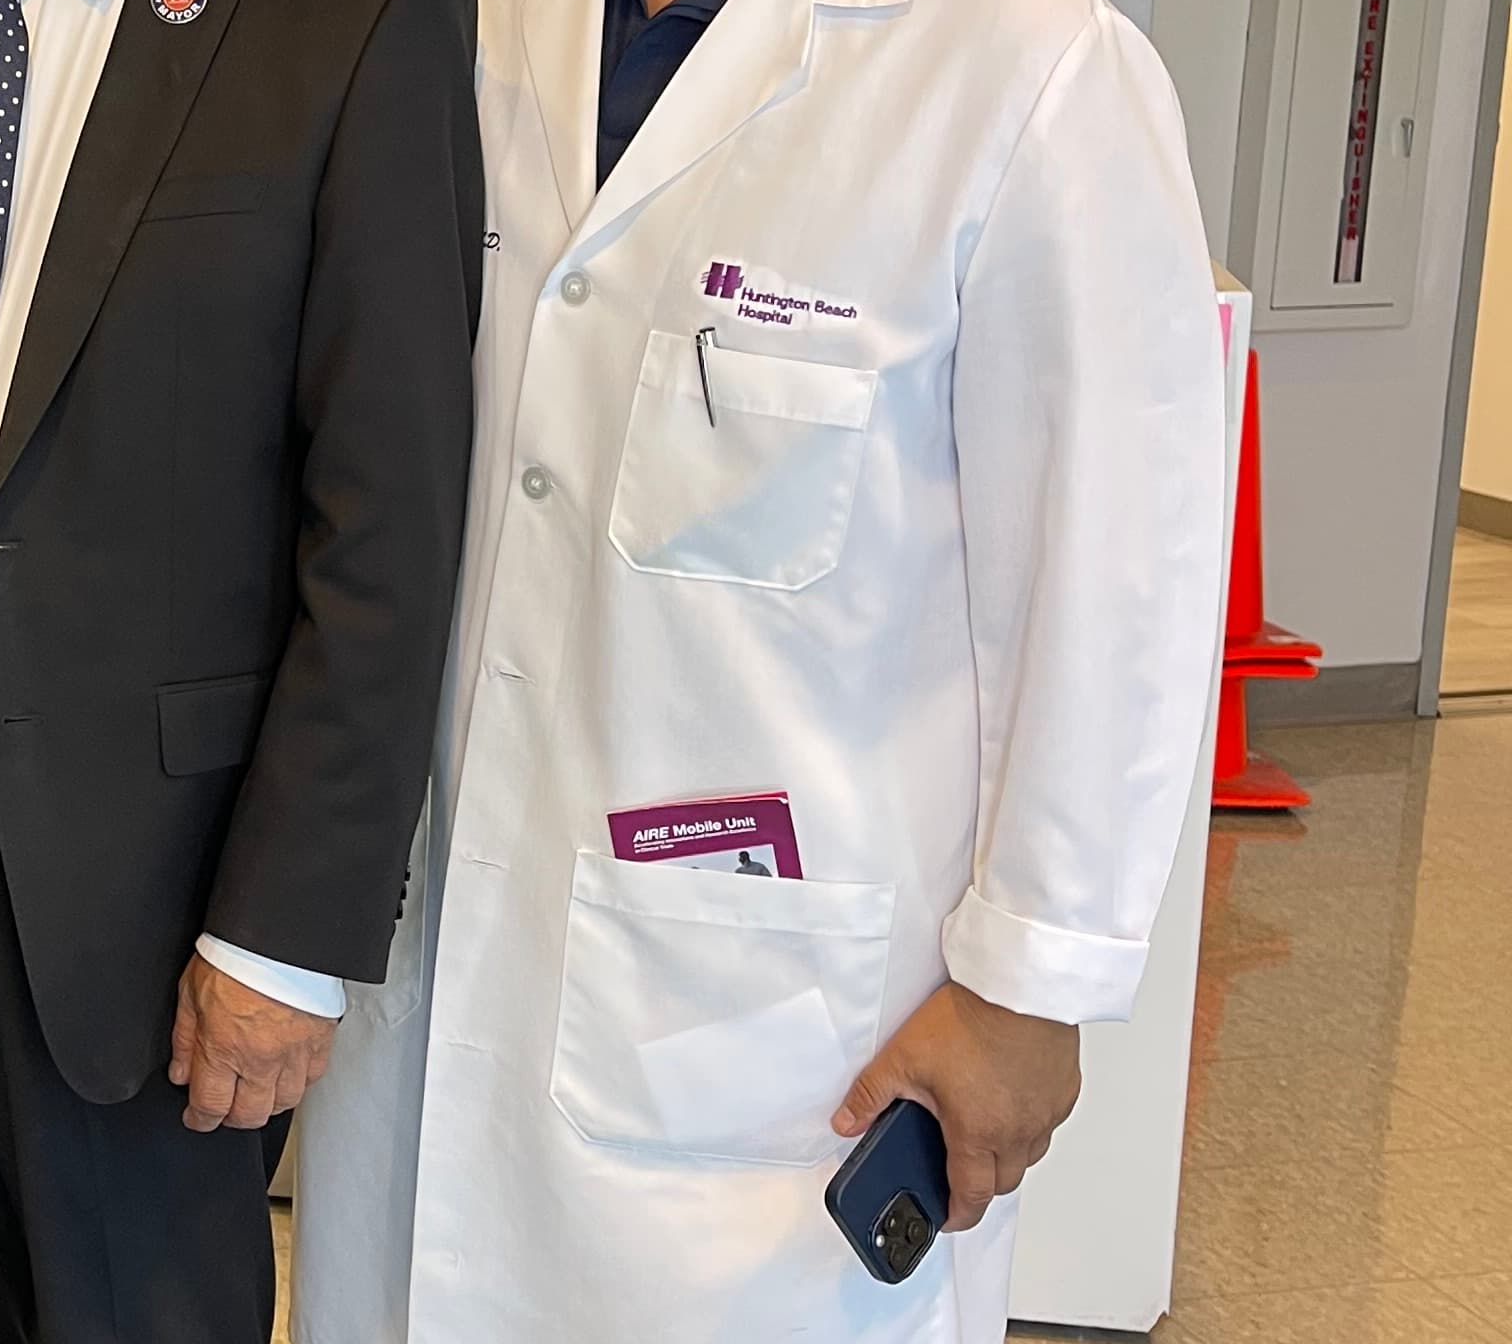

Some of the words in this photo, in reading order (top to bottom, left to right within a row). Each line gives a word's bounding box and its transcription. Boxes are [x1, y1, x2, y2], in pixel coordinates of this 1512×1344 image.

[158, 3, 201, 20] MAYOR
[1345, 41, 1375, 241] EXTINGUISHER
[737, 304, 792, 325] Hospital
[740, 287, 810, 311] Huntington
[814, 299, 858, 320] Beach
[632, 827, 670, 843] AIRE
[673, 820, 722, 836] Mobile
[725, 817, 756, 830] Unit
